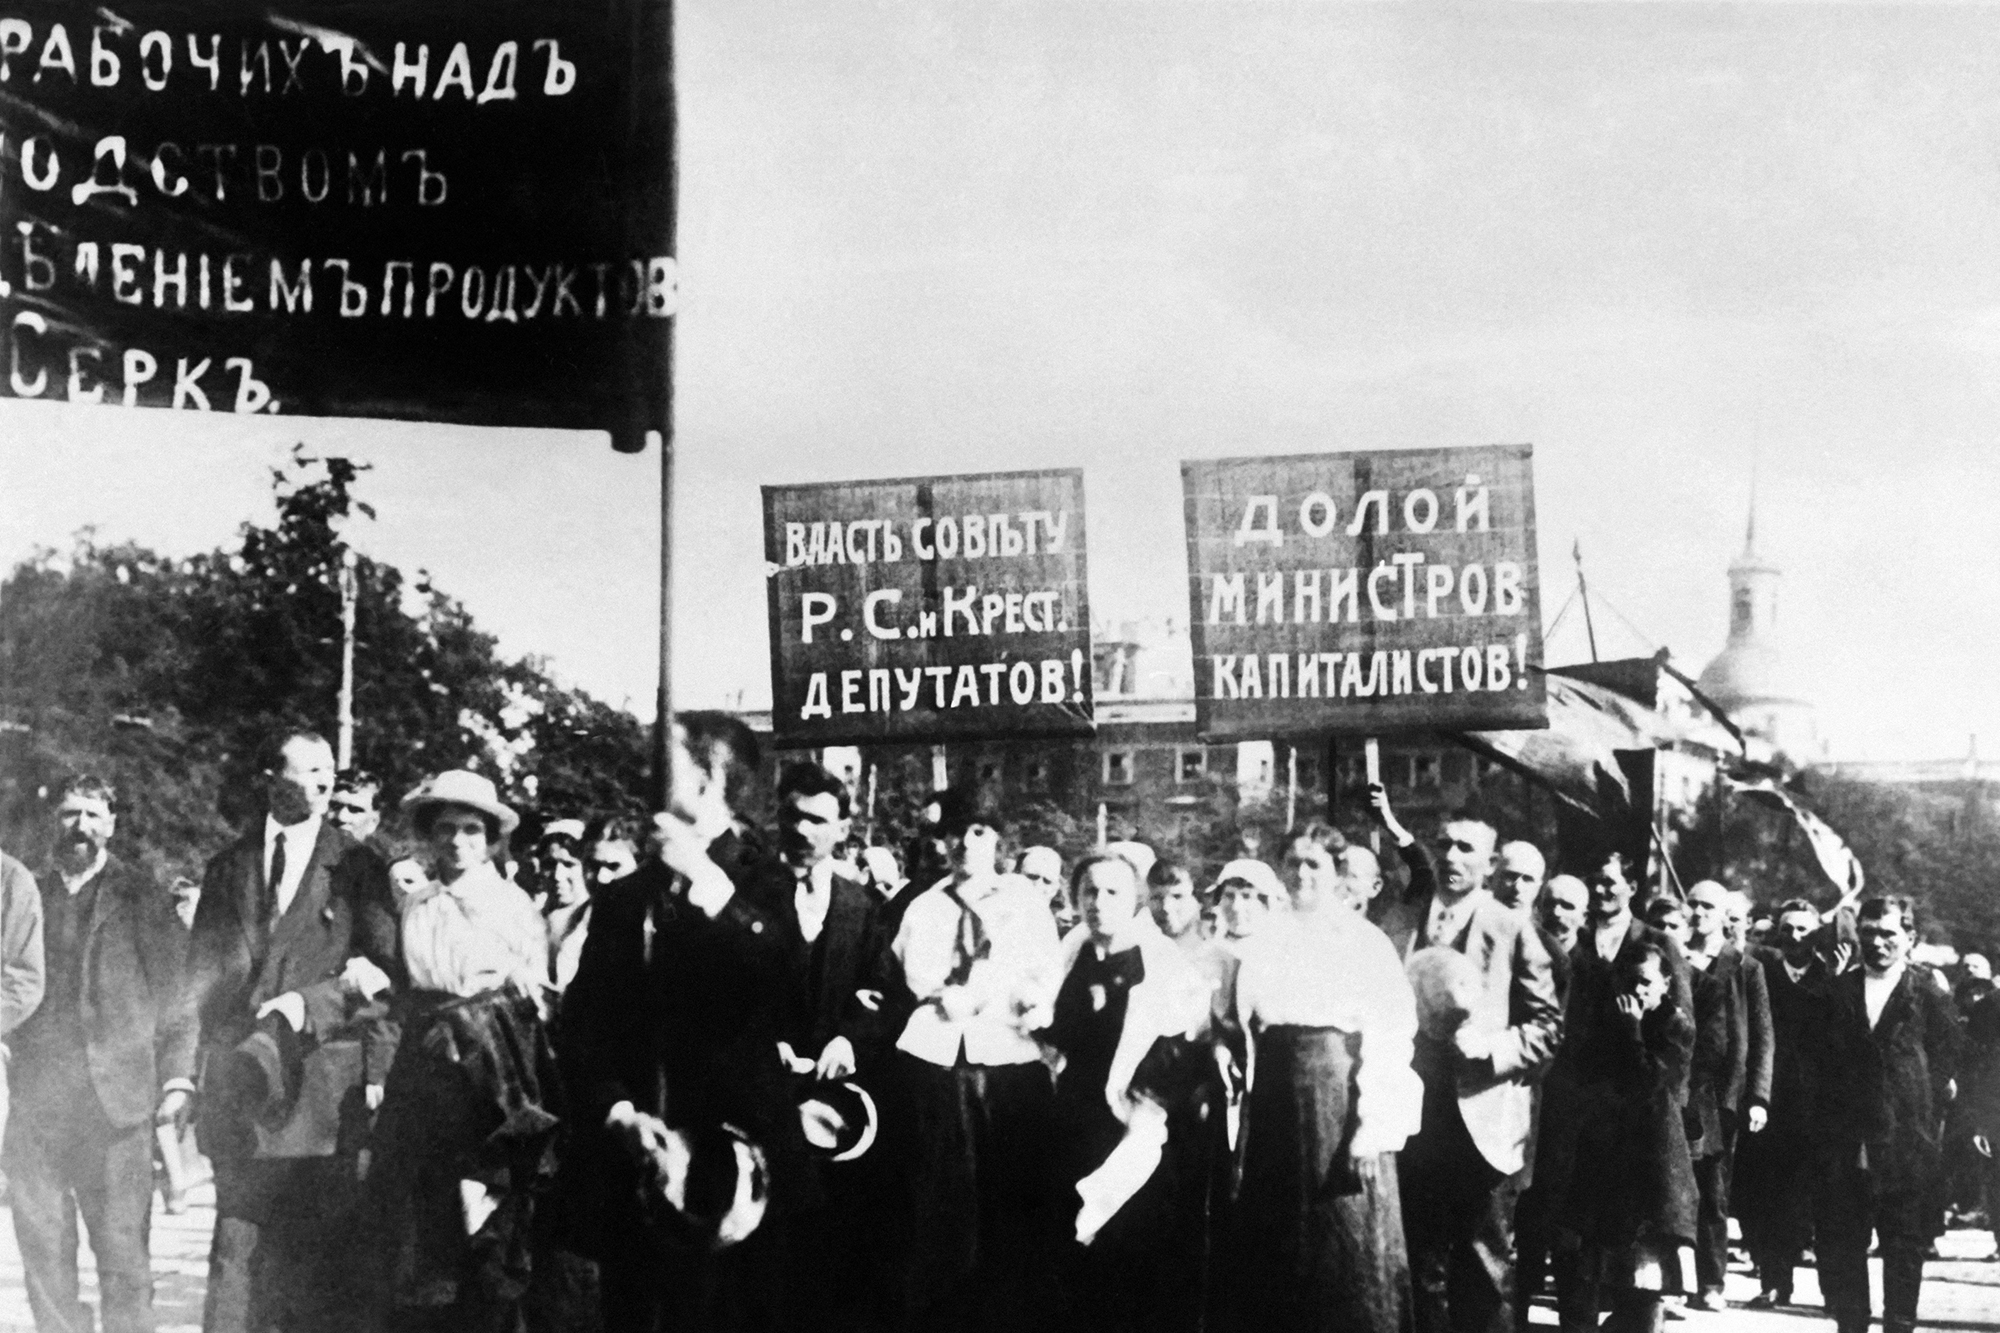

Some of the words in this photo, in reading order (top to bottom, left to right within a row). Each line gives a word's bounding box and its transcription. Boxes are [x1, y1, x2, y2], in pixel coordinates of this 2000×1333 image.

[0, 18, 369, 97] РАБОЧИХЪ
[391, 38, 577, 103] НАДЪ
[0, 132, 447, 206] ОДСТВОМЪ
[0, 221, 367, 318] ѢЛЕНІЕМЪ
[1234, 473, 1491, 548] ДОЛОЙ
[1210, 552, 1525, 625] МИНИСТРОВ
[801, 648, 1085, 720] ДЕПУТАТОВ!
[1213, 633, 1529, 699] КАПИТАЛИСТОВ!
